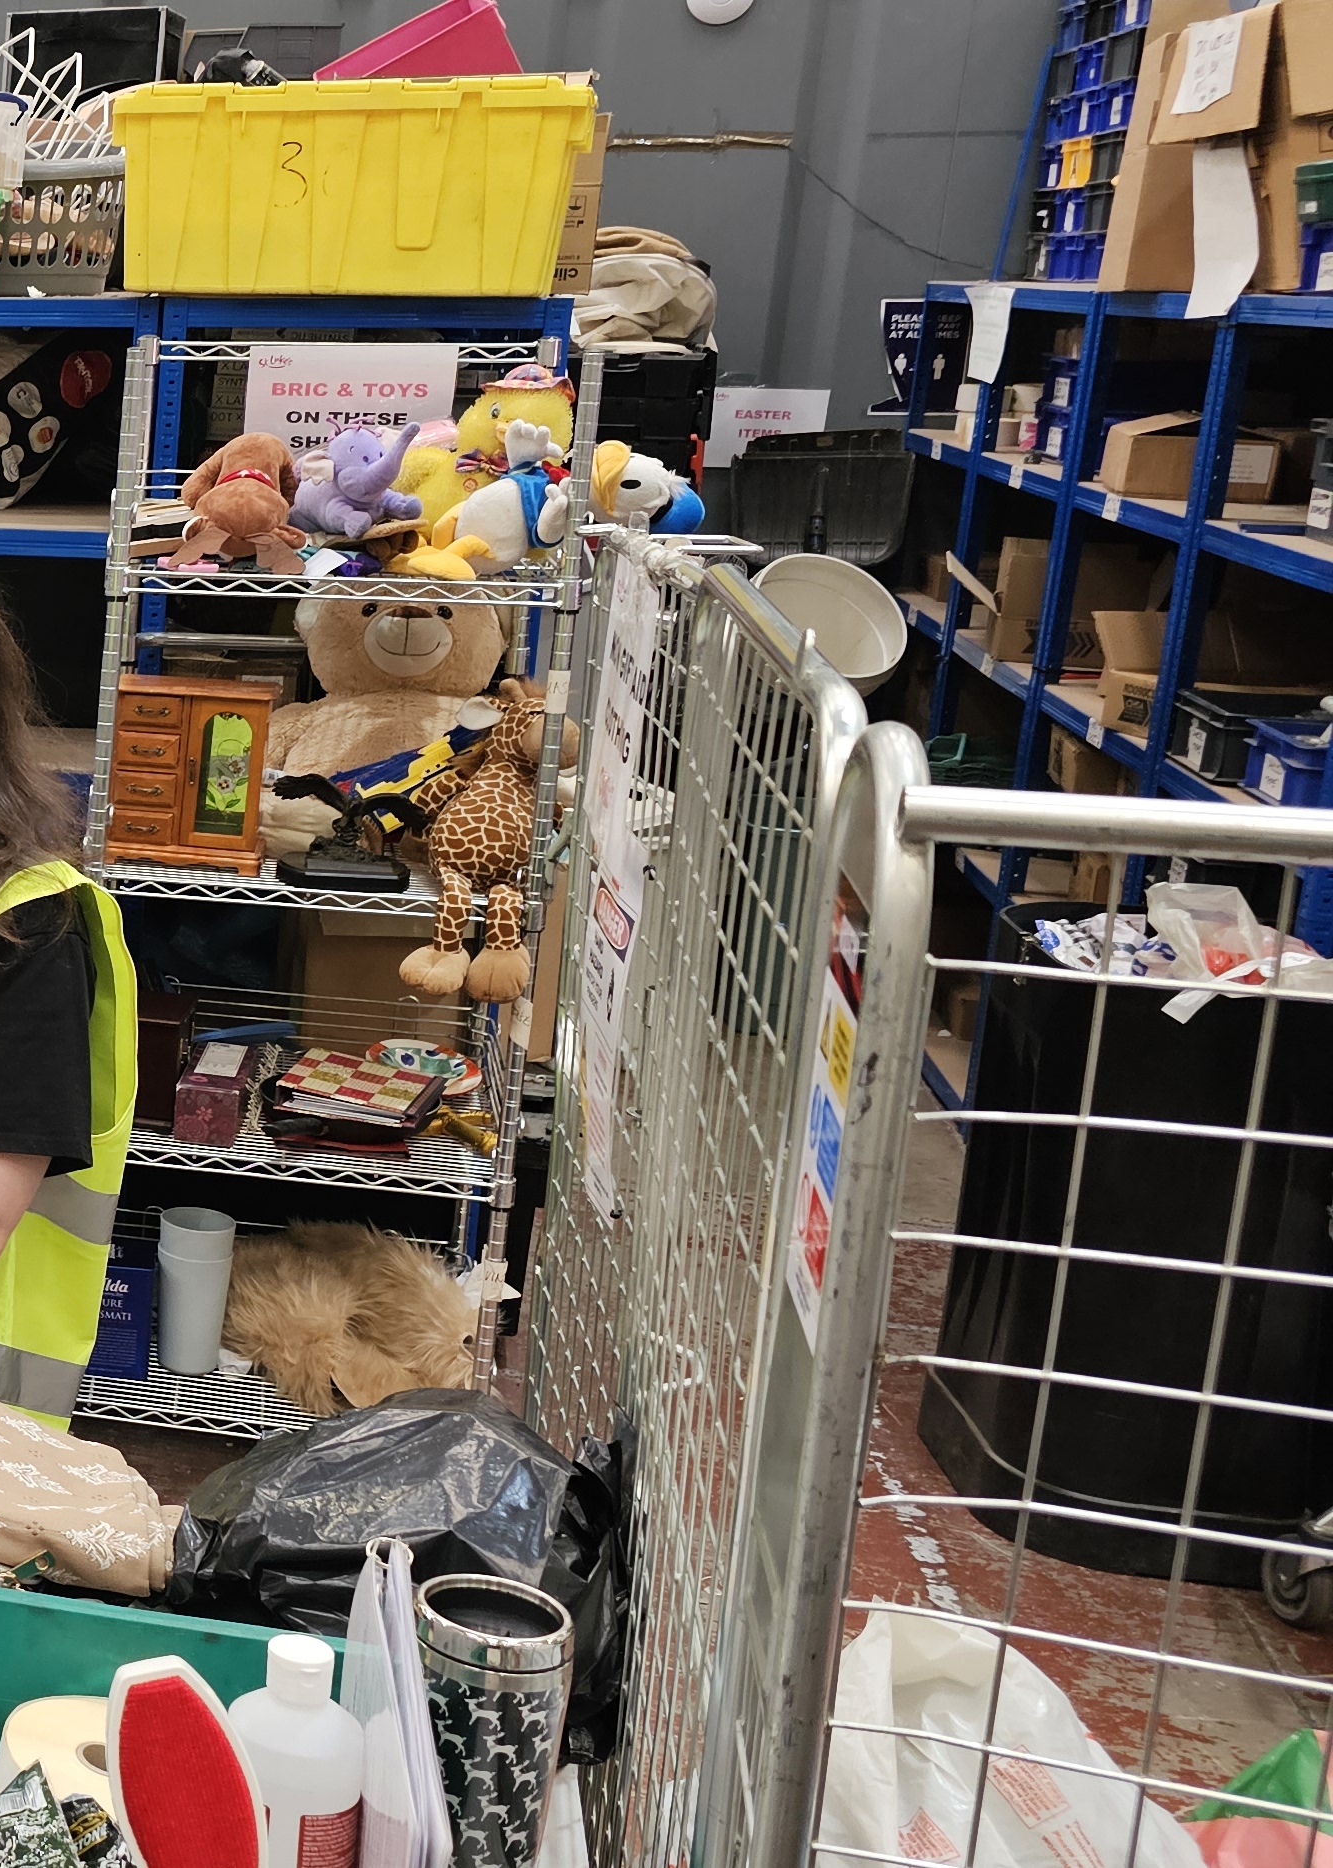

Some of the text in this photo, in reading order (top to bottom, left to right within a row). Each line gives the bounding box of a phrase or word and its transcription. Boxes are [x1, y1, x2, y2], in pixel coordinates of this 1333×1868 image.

[276, 141, 309, 207] 3
[888, 330, 904, 339] AT
[935, 330, 960, 339] IMES
[271, 382, 429, 398] BRIC & TOYS
[285, 410, 409, 426] ON THESE
[734, 409, 792, 420] EASTER
[289, 435, 330, 450] SH
